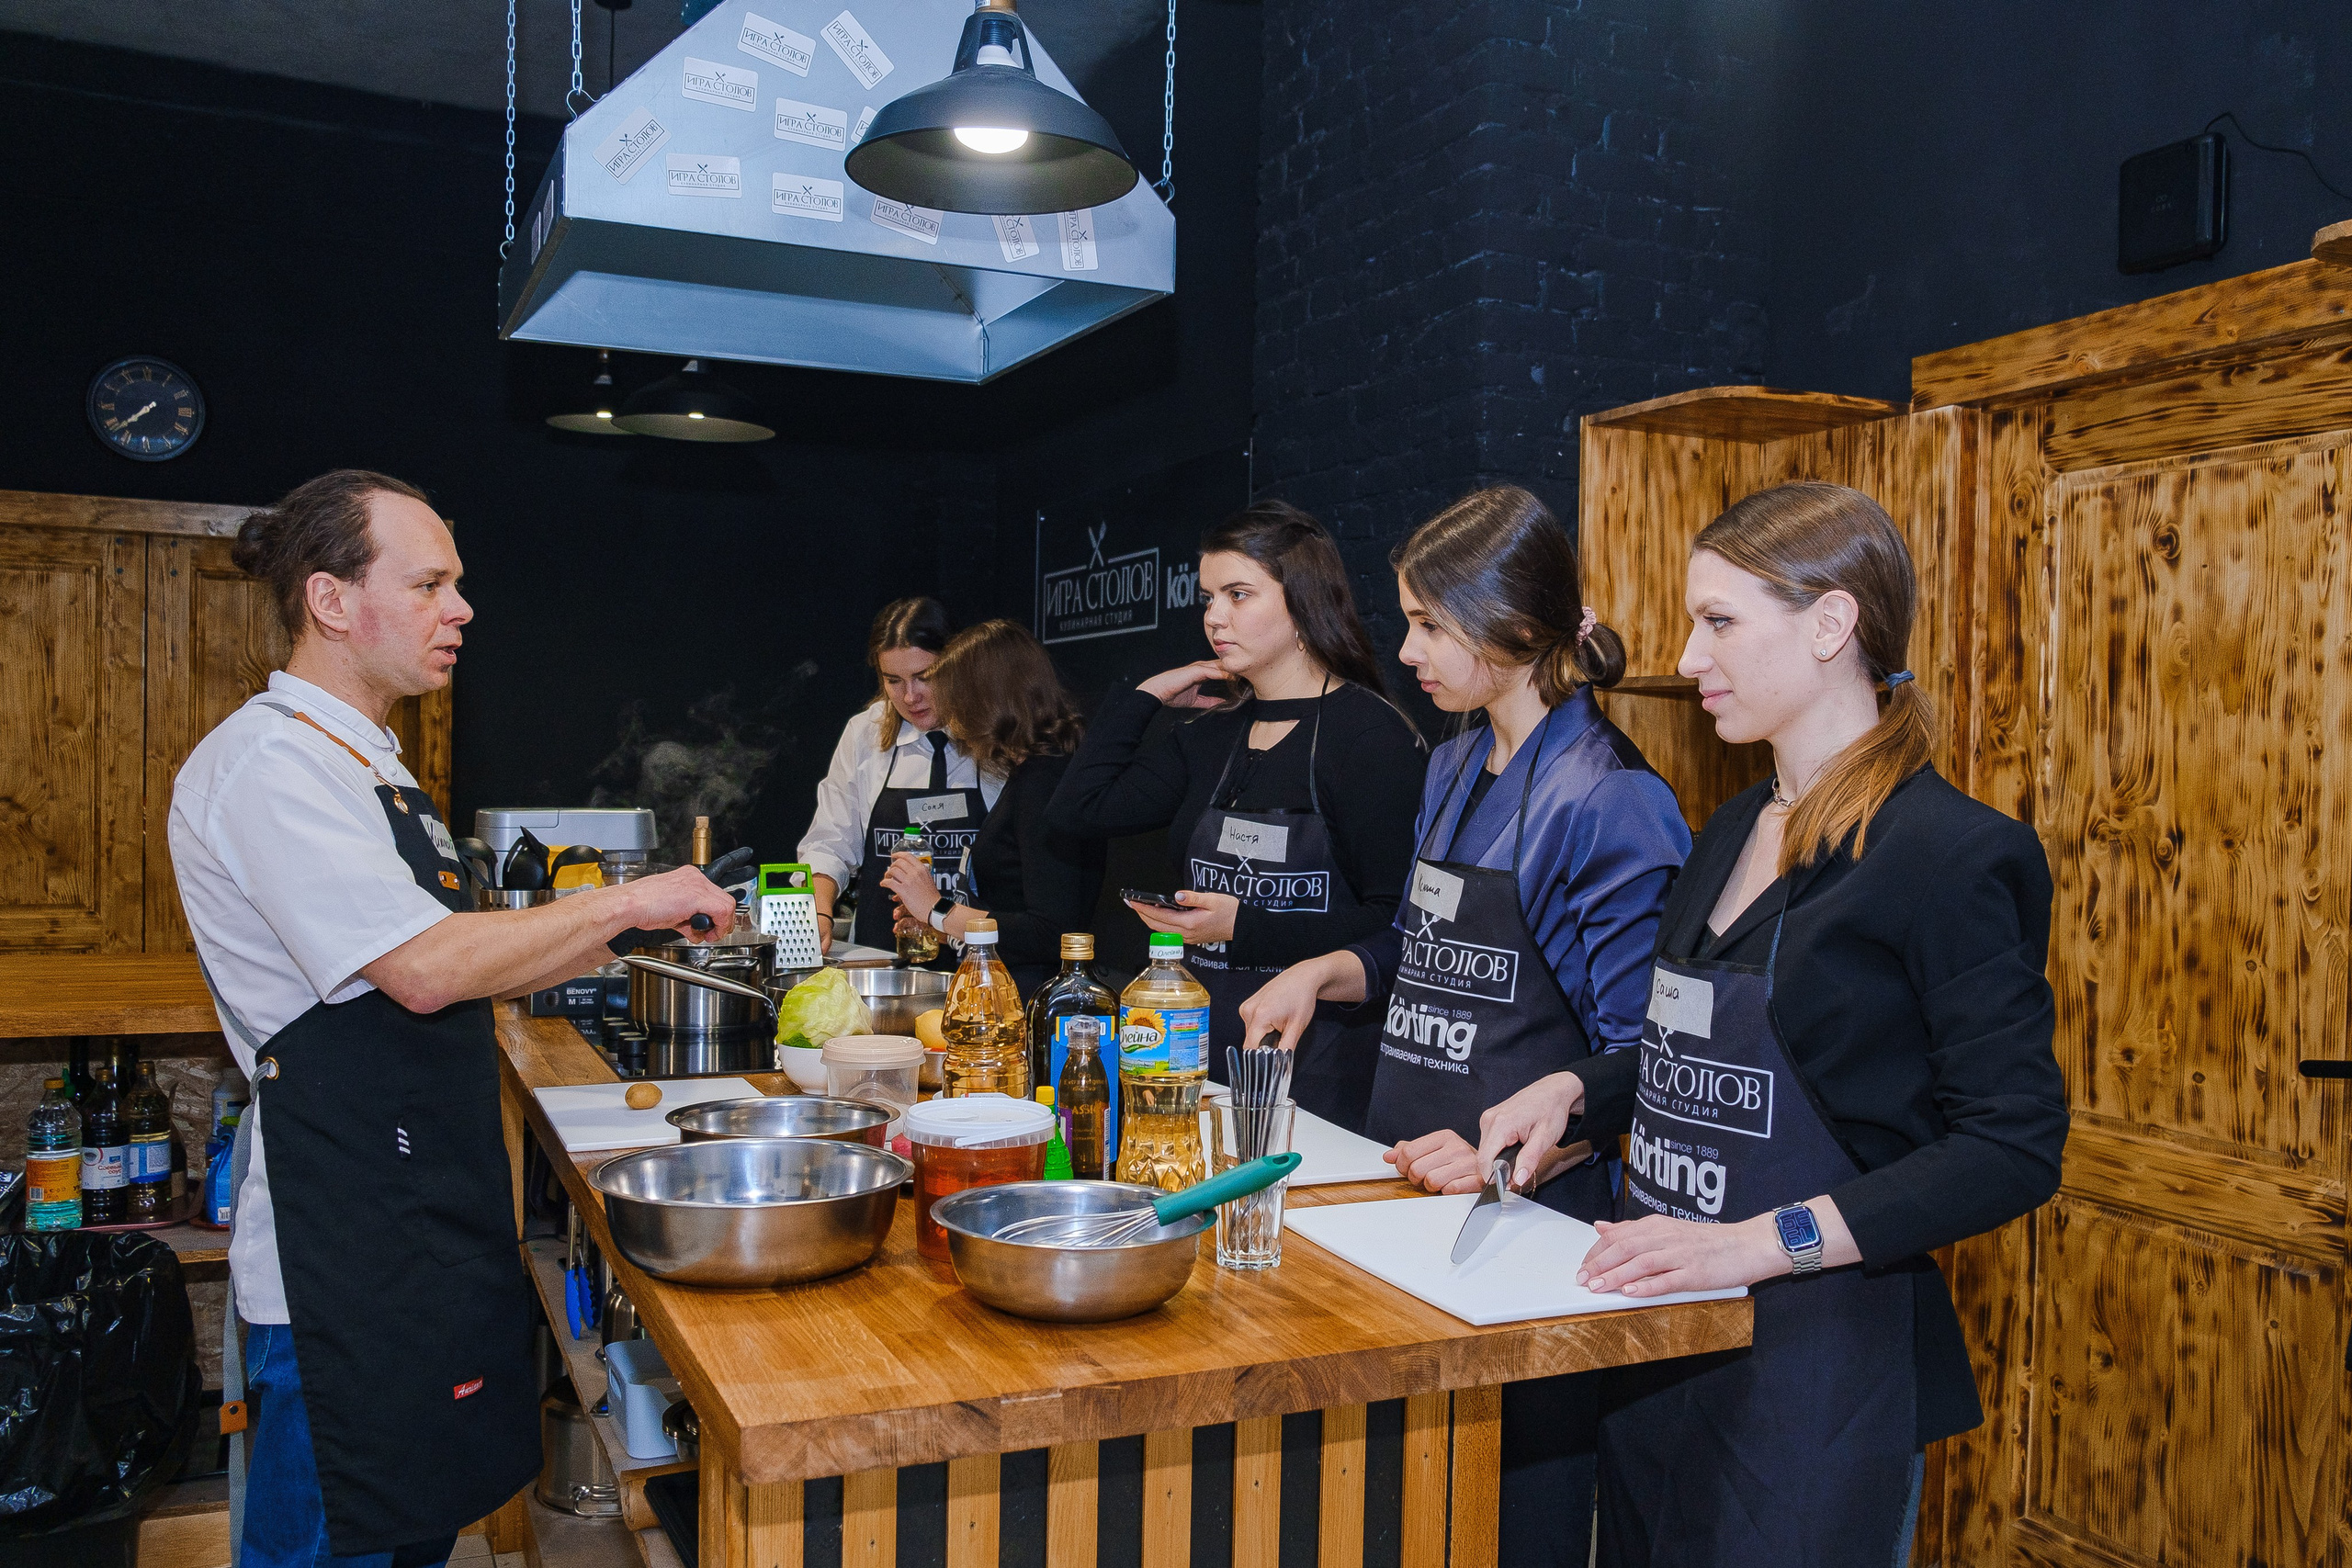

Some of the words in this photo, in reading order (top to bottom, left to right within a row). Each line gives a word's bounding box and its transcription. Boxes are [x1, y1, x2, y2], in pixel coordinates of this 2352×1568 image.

[745, 29, 767, 47] ИГРА
[770, 41, 808, 63] СТОЛОВ
[832, 24, 851, 47] ИГРА
[851, 45, 878, 79] СТОЛОВ
[687, 75, 711, 89] ИГРА
[713, 82, 752, 97] СТОЛОВ
[779, 116, 803, 129] ИГРА
[804, 121, 842, 137] СТОЛОВ
[609, 152, 631, 172] ИГРА
[628, 122, 659, 153] СТОЛОВ
[671, 172, 695, 182] ИГРА
[697, 173, 736, 185] СТОЛОВ
[775, 191, 799, 202] ИГРА
[800, 195, 839, 208] СТОЛОВ
[877, 203, 899, 218] ИГРА
[901, 212, 935, 231] СТОЛОВ
[1046, 579, 1083, 616] ИГРА
[1086, 561, 1154, 609] СТОЛОВ
[1104, 609, 1133, 626] СТУДИЯ
[876, 831, 900, 847] ИГР
[922, 833, 977, 849] ТОЛО
[1230, 826, 1259, 845] Настя
[1195, 864, 1230, 892] ИГРА
[1233, 874, 1322, 897] СТОЛОВ
[1402, 936, 1412, 964] РА
[1415, 942, 1509, 982] СТОЛОВ
[1430, 974, 1471, 988] СТУДИЯ
[1657, 978, 1679, 999] Саша
[1428, 1005, 1449, 1016] since
[1452, 1010, 1473, 1020] 1889
[1423, 1057, 1469, 1074] техника
[1653, 1058, 1761, 1110] СТОЛОВ
[1672, 1100, 1718, 1118] СТУДИЯ
[1670, 1140, 1692, 1154] since
[1696, 1145, 1719, 1159] 1889
[1629, 1117, 1726, 1214] körting
